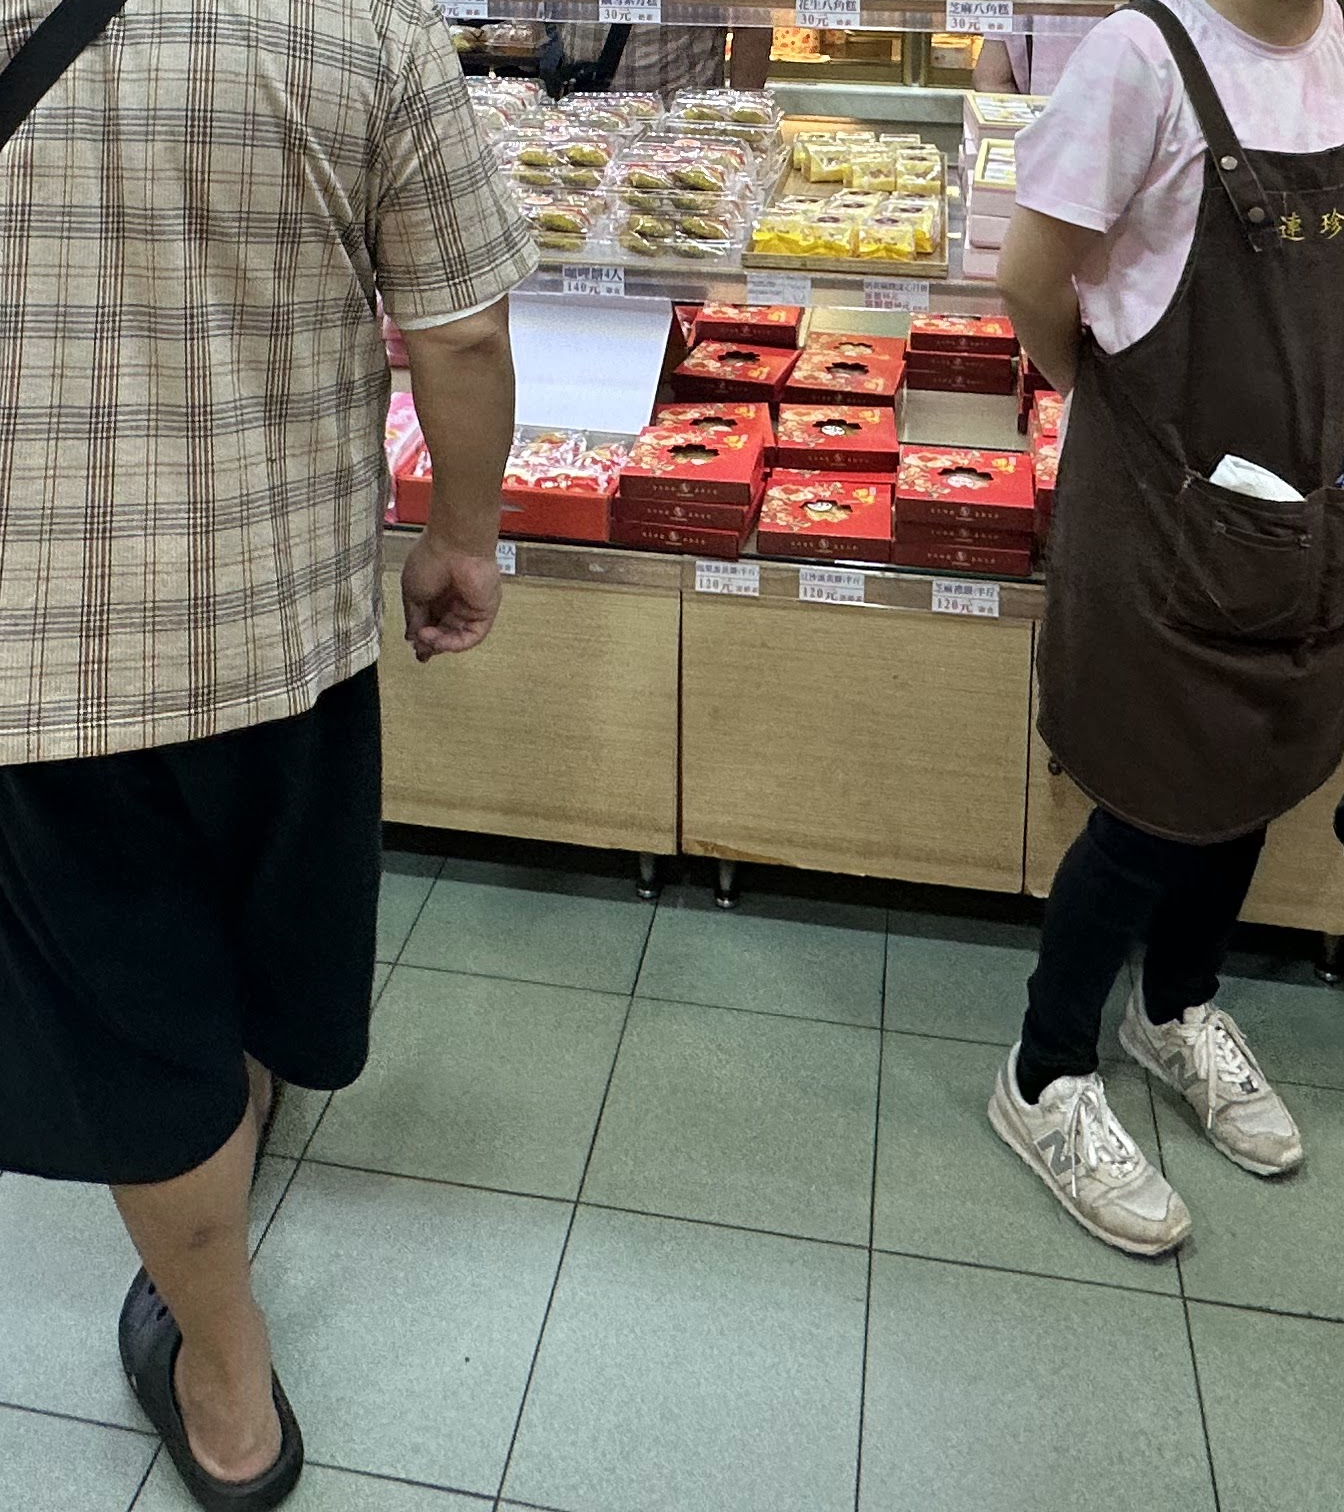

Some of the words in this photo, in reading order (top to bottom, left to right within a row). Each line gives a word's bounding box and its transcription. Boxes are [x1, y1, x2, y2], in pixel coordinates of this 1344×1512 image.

[603, 8, 632, 22] 30元
[948, 1, 1010, 15] 芝麻八角糕
[800, 13, 829, 27] 30元
[950, 17, 981, 31] 30元
